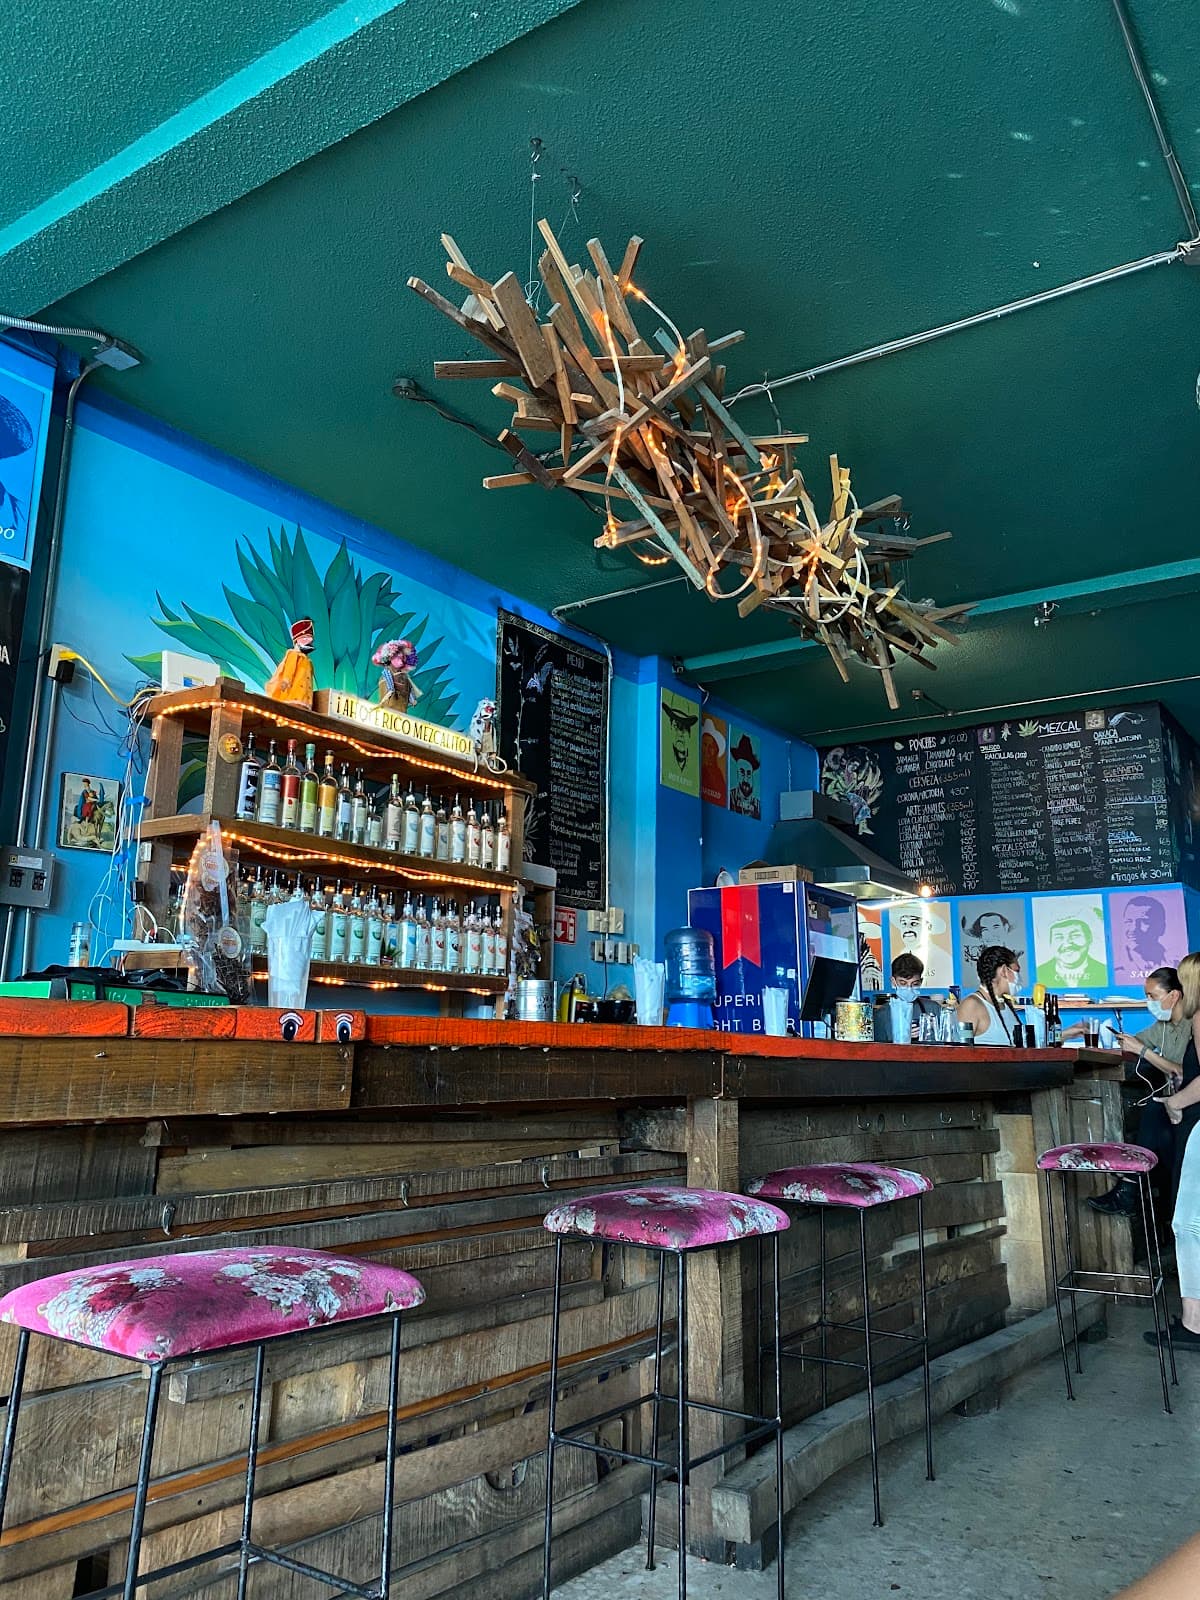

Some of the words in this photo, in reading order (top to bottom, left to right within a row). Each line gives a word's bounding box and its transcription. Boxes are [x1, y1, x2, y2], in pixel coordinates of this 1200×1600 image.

[382, 711, 411, 735] RICO
[414, 722, 471, 755] MEZCALITO!
[1038, 720, 1082, 735] MEZCAL
[908, 736, 937, 751] PONCHES
[908, 774, 939, 789] CERVEZA
[1140, 870, 1148, 880] de
[1129, 970, 1150, 979] SAU
[713, 994, 761, 1007] UPERI
[713, 1018, 741, 1032] GHT
[752, 1018, 796, 1031] BR
